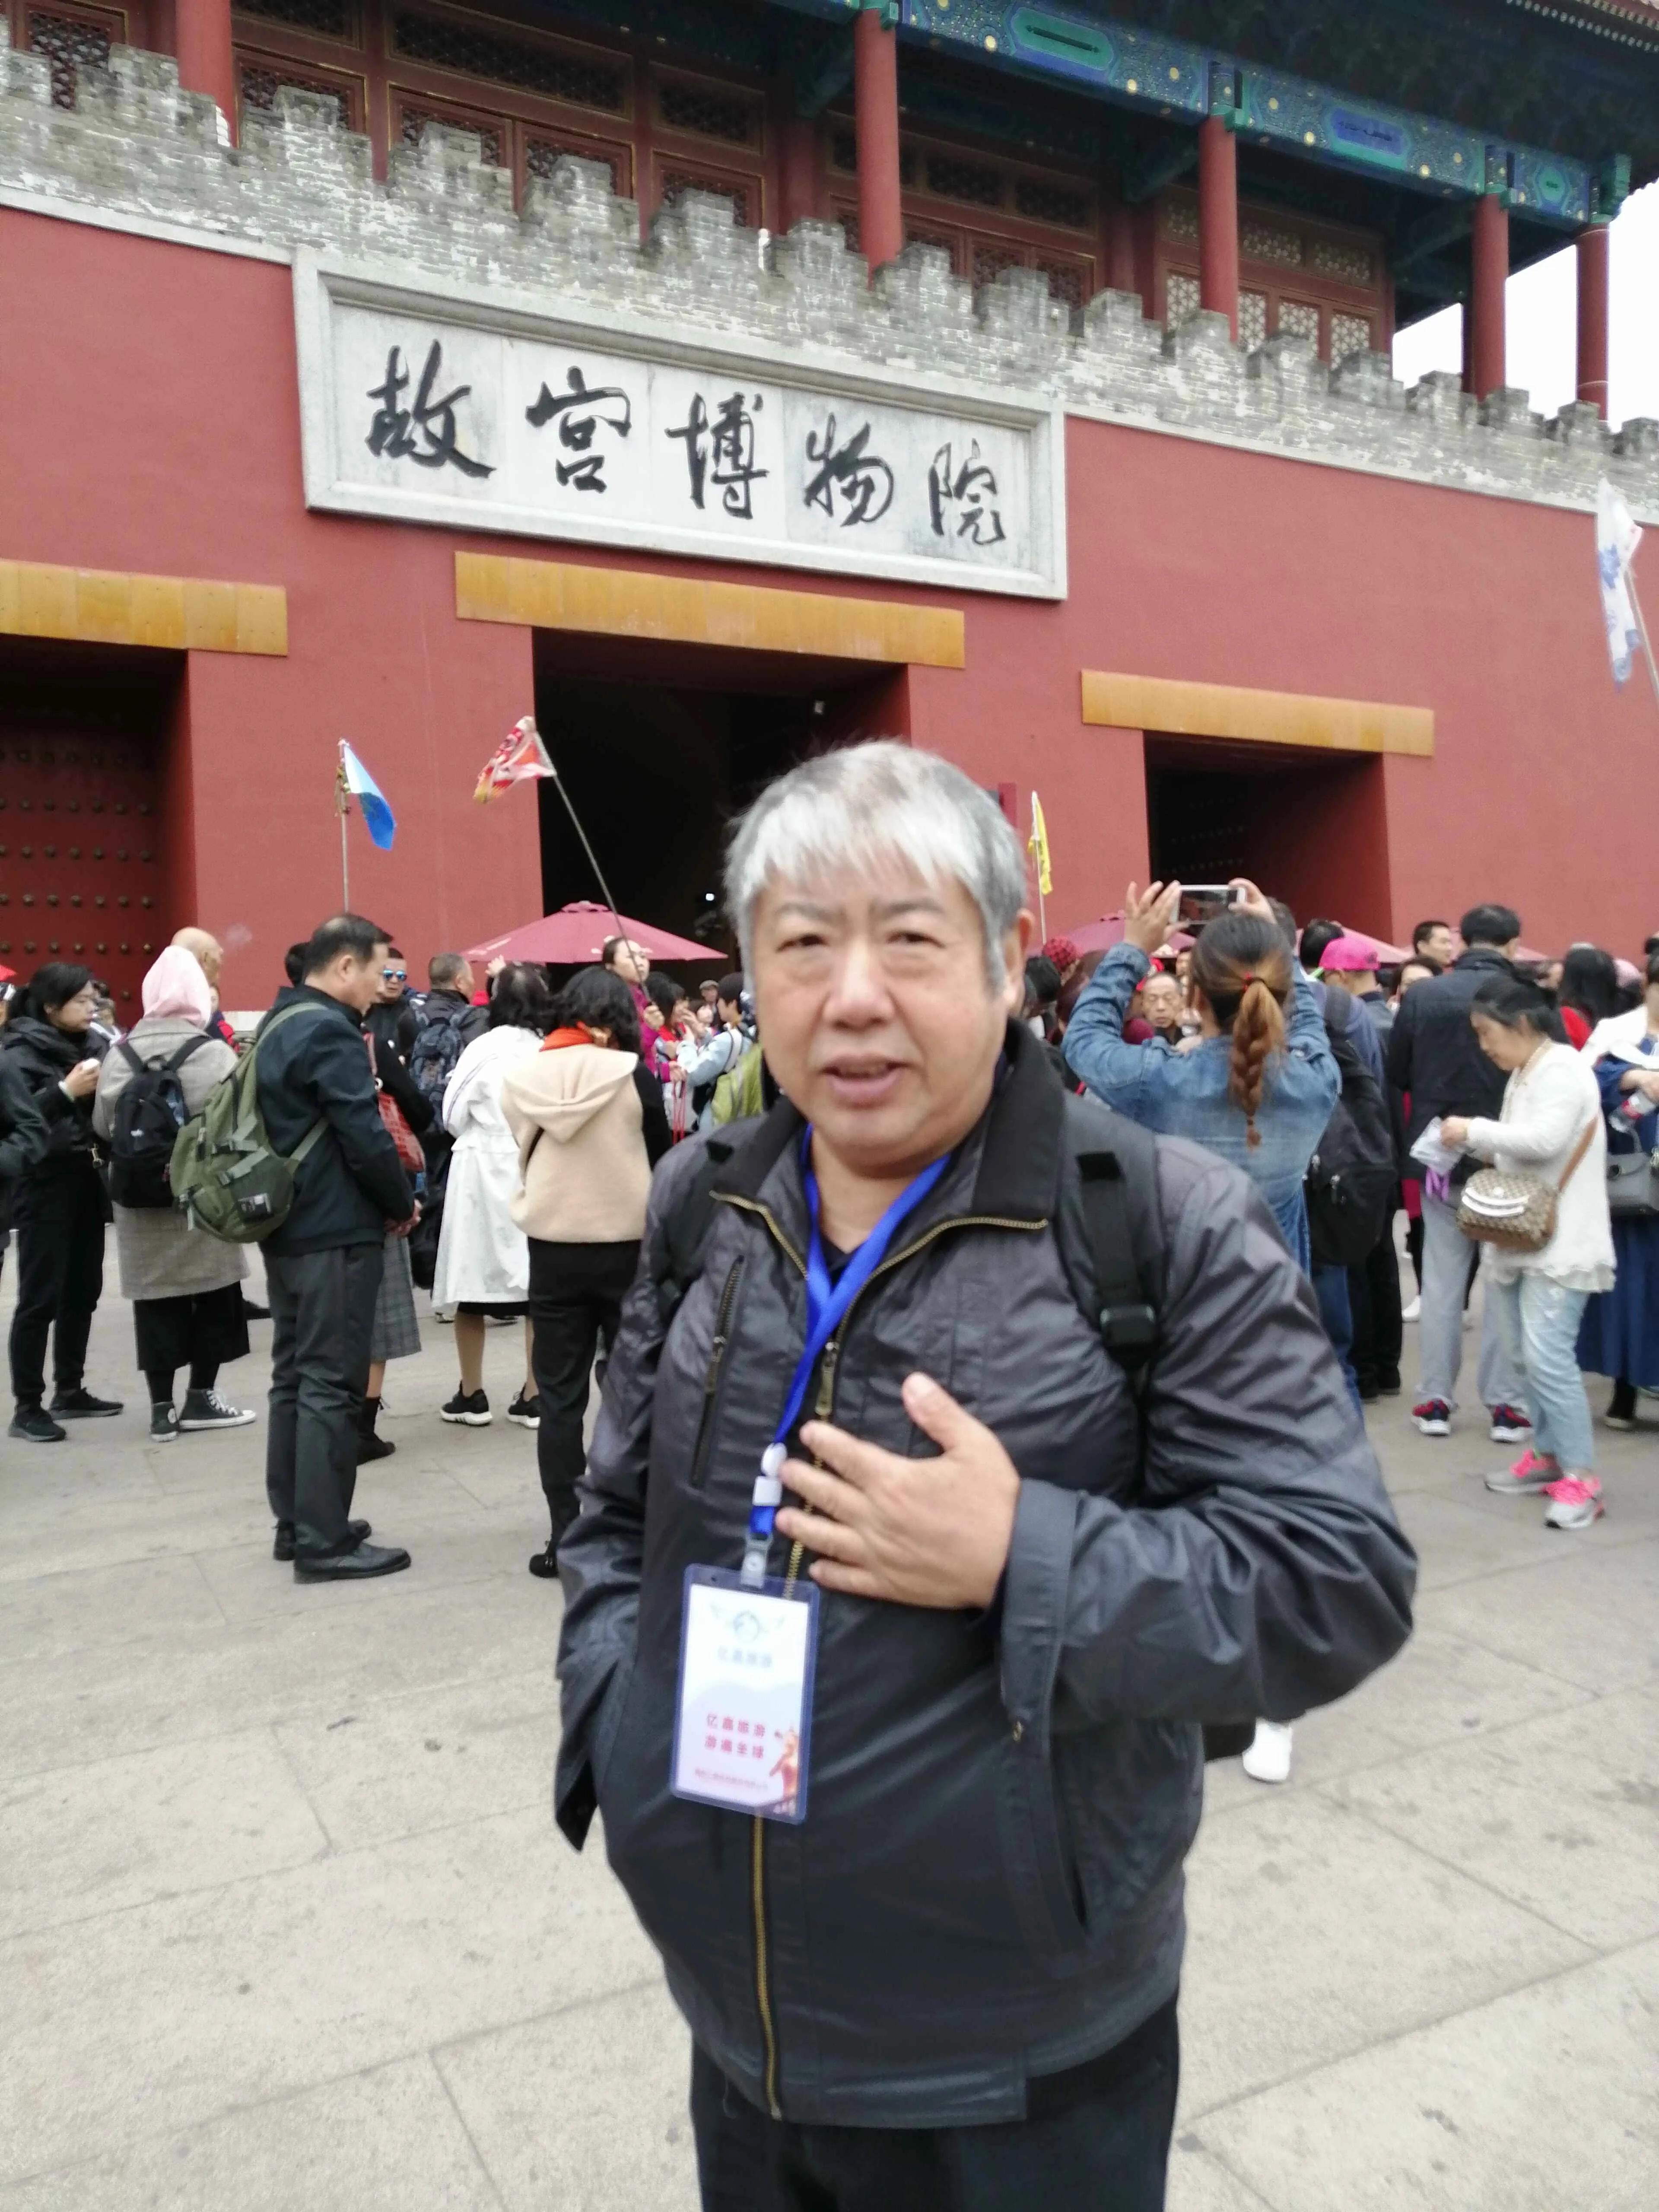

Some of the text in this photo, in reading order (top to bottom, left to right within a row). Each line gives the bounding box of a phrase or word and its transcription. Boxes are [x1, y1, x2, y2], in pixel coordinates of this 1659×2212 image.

[365, 338, 1006, 546] 故宫博物院
